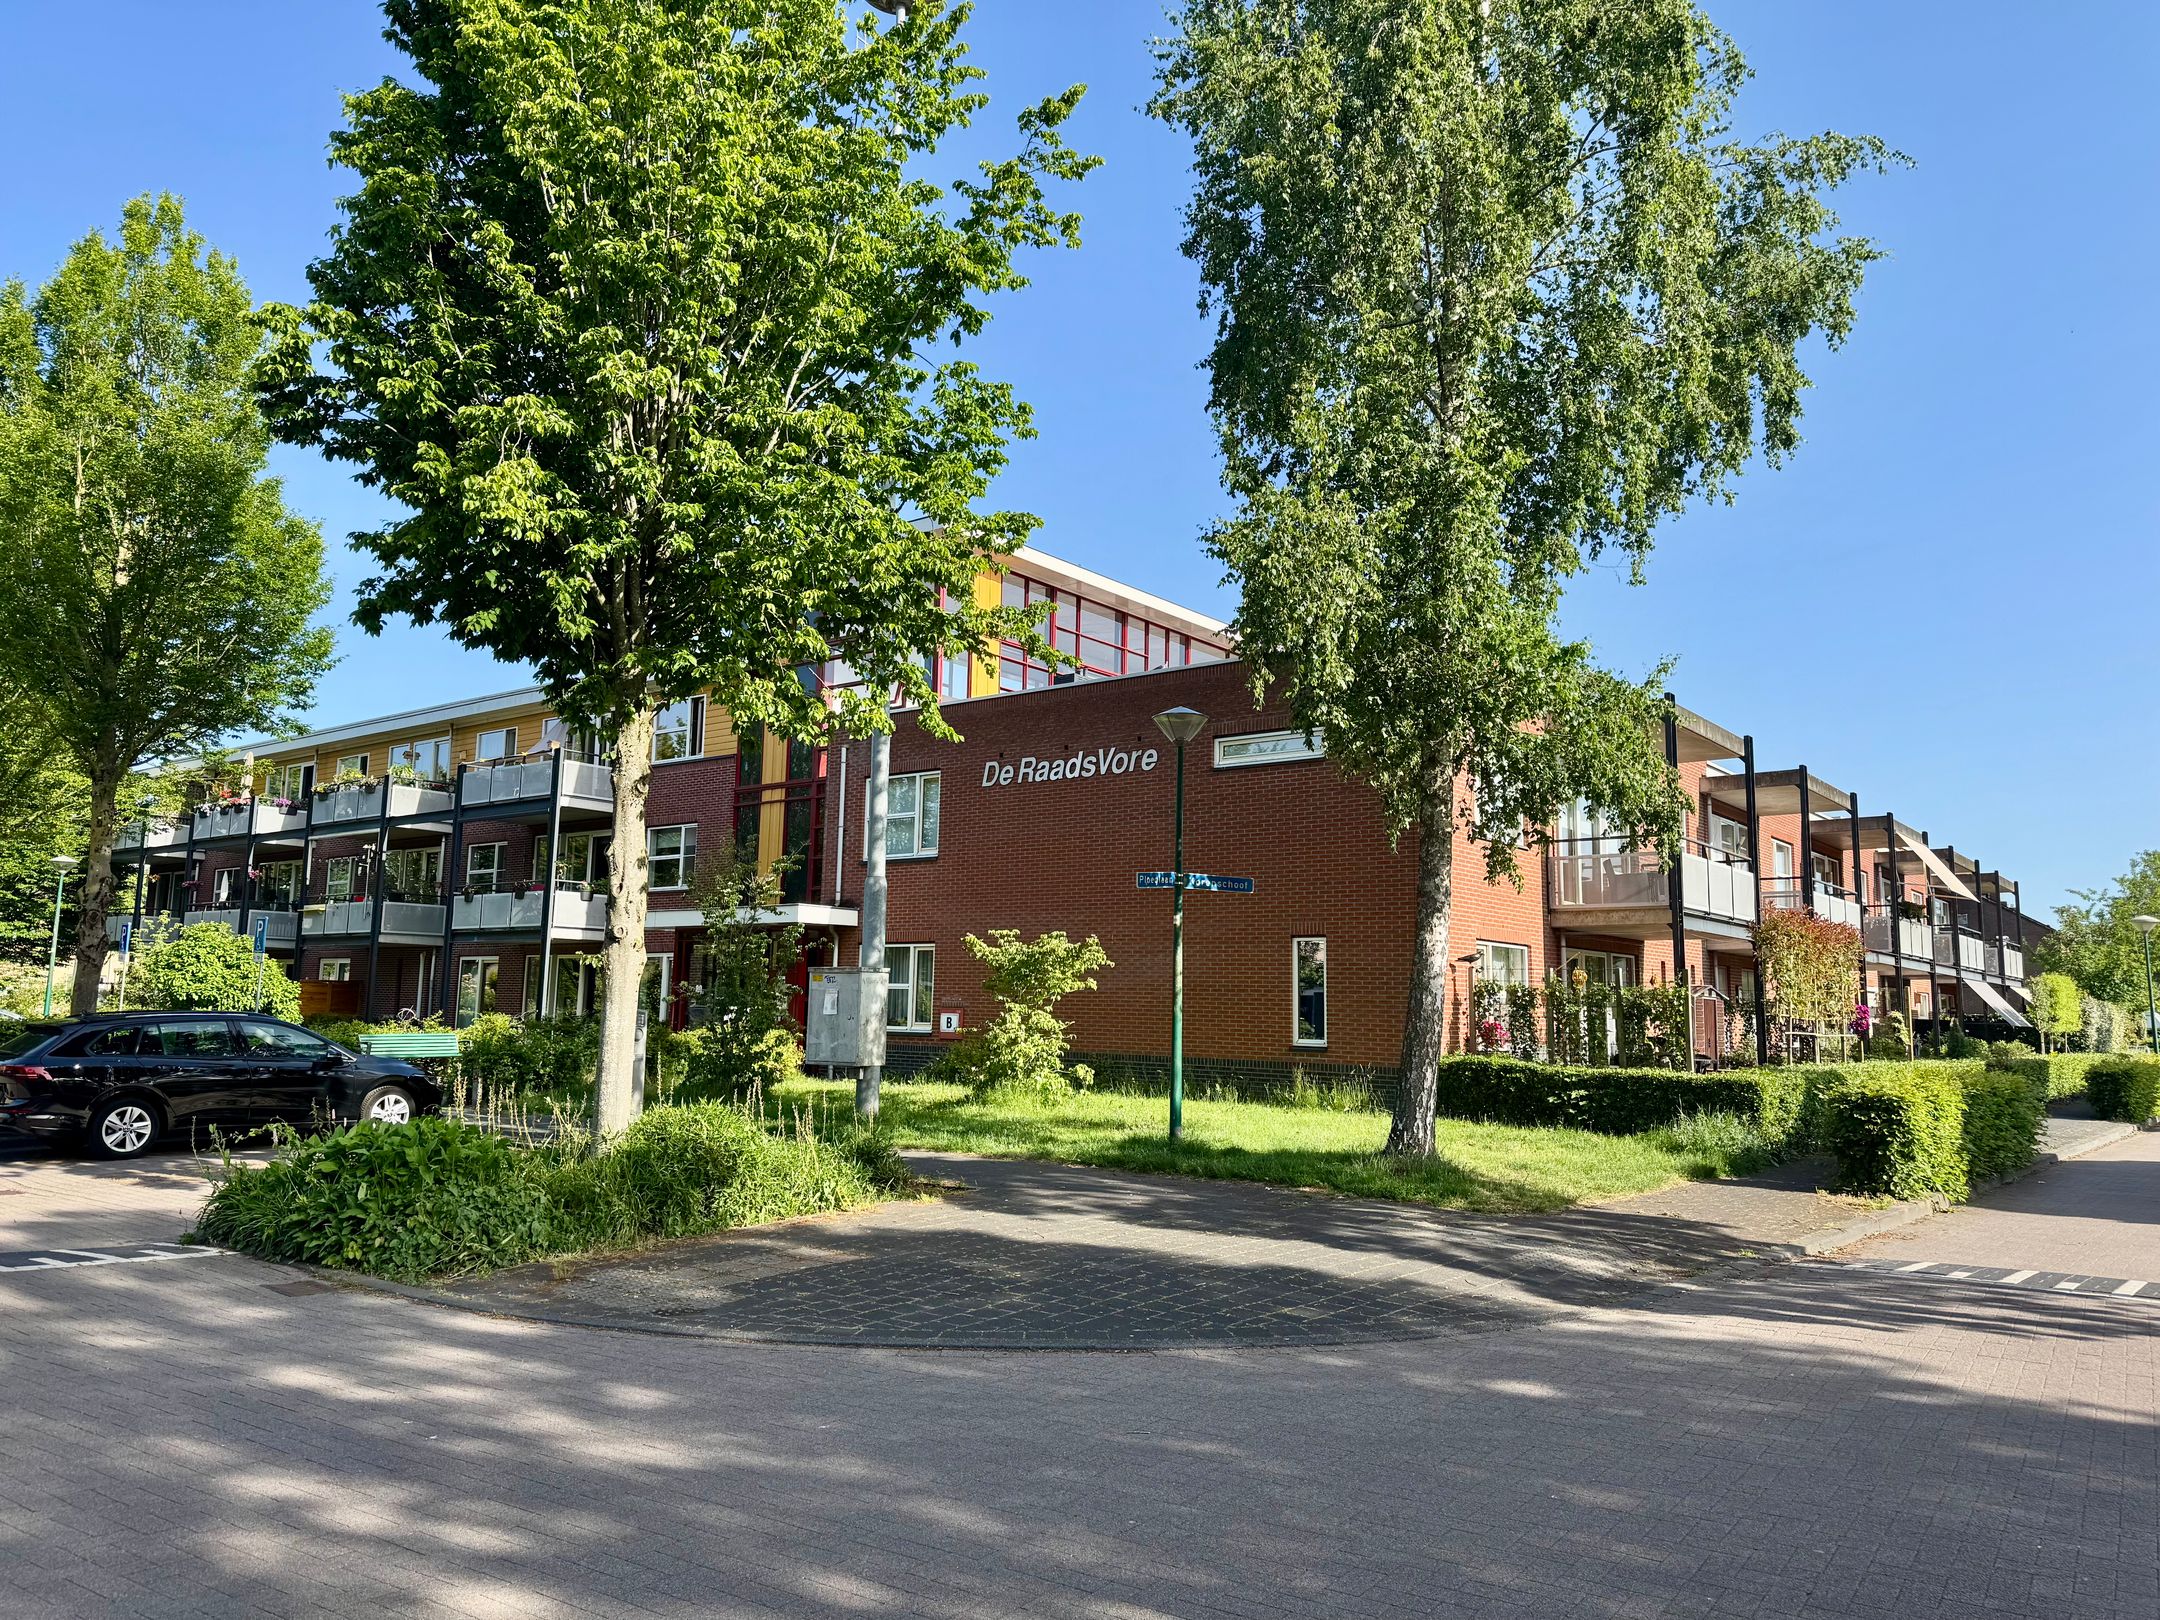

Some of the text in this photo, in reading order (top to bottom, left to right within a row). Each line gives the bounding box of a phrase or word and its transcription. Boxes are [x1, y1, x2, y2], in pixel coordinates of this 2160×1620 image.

[982, 760, 1014, 787] De
[1139, 875, 1174, 886] Ploeglaan
[257, 920, 264, 936] P
[946, 1016, 953, 1029] B
